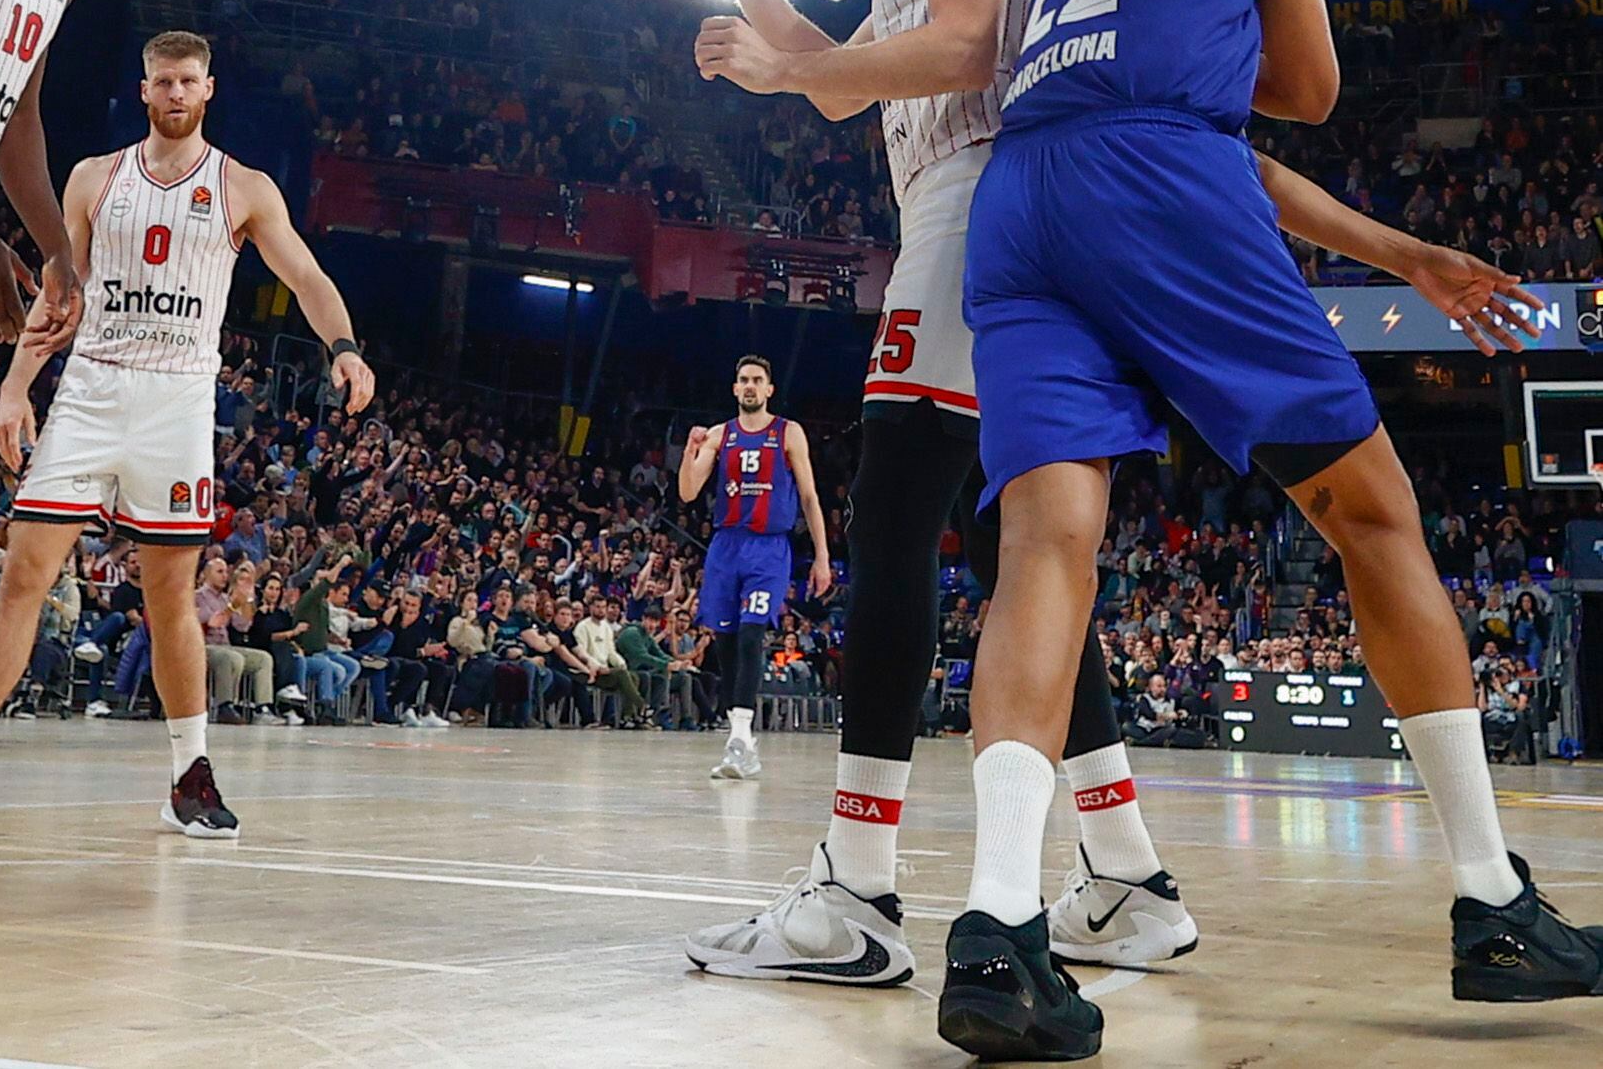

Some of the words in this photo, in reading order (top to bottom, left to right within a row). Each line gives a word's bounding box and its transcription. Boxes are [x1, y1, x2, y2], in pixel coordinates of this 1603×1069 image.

[2, 3, 44, 62] 10
[143, 224, 171, 265] 0
[739, 450, 761, 472] 13
[749, 590, 771, 615] 13
[835, 794, 882, 819] GSA
